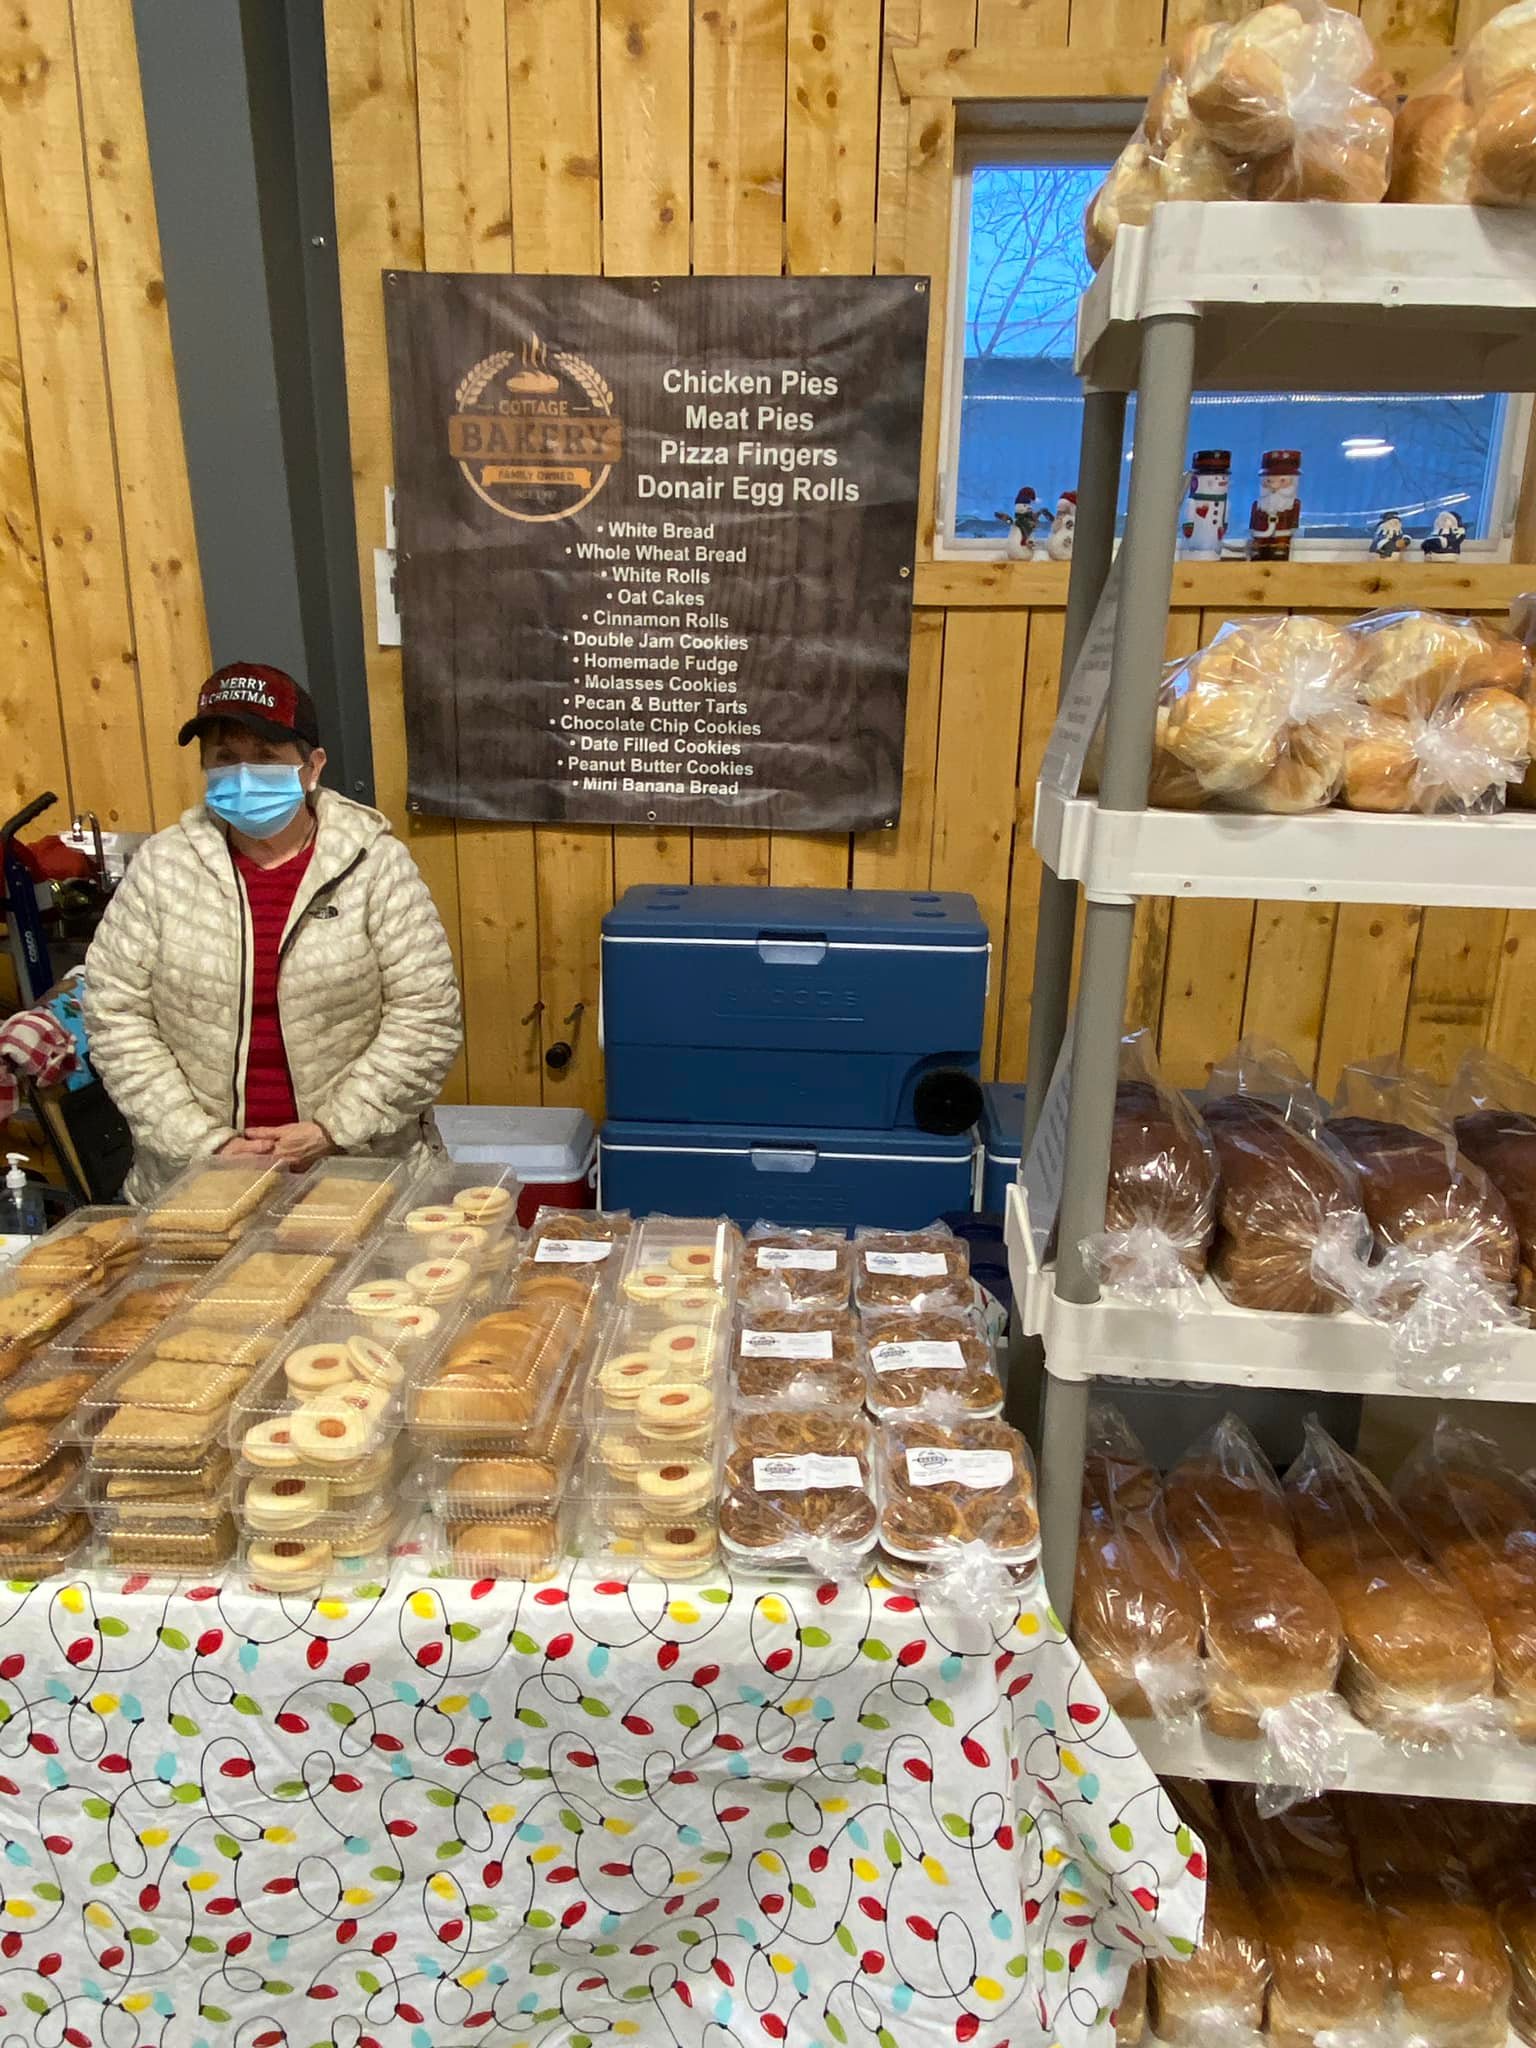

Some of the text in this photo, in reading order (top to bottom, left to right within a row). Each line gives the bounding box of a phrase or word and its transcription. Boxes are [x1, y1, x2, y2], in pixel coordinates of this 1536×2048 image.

[662, 368, 839, 397] Chicken Pies
[500, 400, 568, 416] COTTAGE
[685, 404, 814, 432] Meat Pies
[462, 423, 608, 454] BAKERY
[660, 440, 838, 473] Pizza Fingers
[637, 474, 860, 507] Donair Egg Rolls
[608, 521, 715, 541] White Bread
[576, 542, 747, 564] Whole Wheat Bread
[611, 565, 711, 585] White Rolls
[617, 588, 705, 608] Oat Cakes
[593, 609, 729, 629] Cinnamon Rolls
[573, 630, 749, 652] Double Jam Cookies
[584, 652, 738, 676] Homemade Fudge
[219, 677, 267, 692] MERRY
[584, 674, 737, 695] Molasses Cookies
[208, 689, 276, 708] CHRISTMAS
[574, 694, 748, 717] Pecan & Butter Tarts
[560, 714, 762, 736] Chocolate Chip Cookies
[580, 735, 742, 756] Date Filled Cookies
[568, 756, 754, 778] Peanut Butter Cookies
[582, 776, 739, 797] Mini Banana Bread
